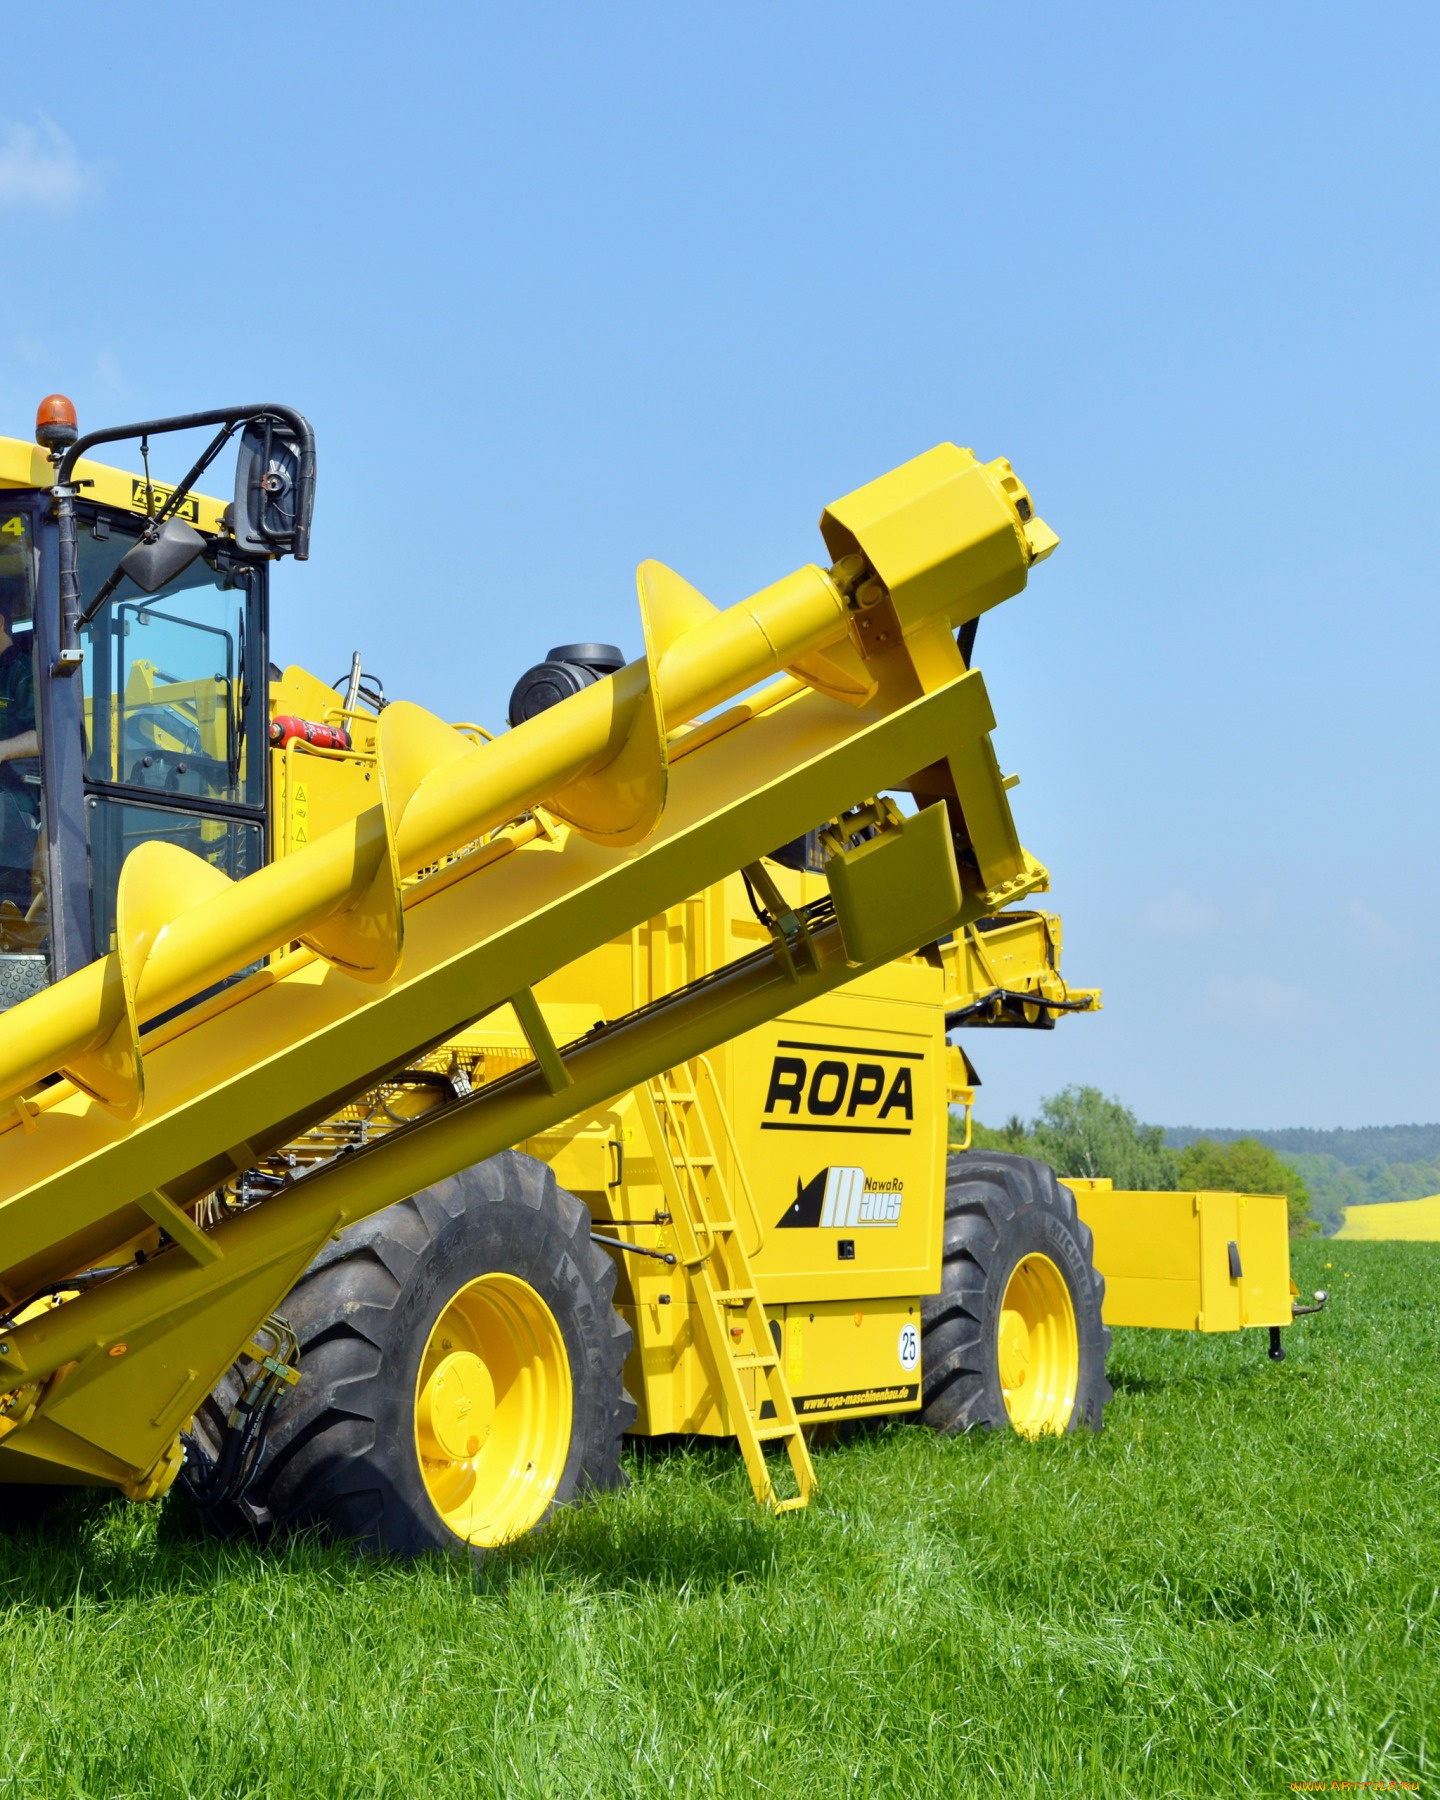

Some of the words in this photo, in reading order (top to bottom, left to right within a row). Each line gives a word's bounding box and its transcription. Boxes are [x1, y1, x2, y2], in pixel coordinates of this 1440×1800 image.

[133, 485, 194, 517] ROA
[763, 1056, 914, 1121] ROPA
[863, 1176, 904, 1192] NawaRo
[902, 1332, 916, 1361] 25
[803, 1386, 910, 1411] www.ropa-maschinenbau.de
